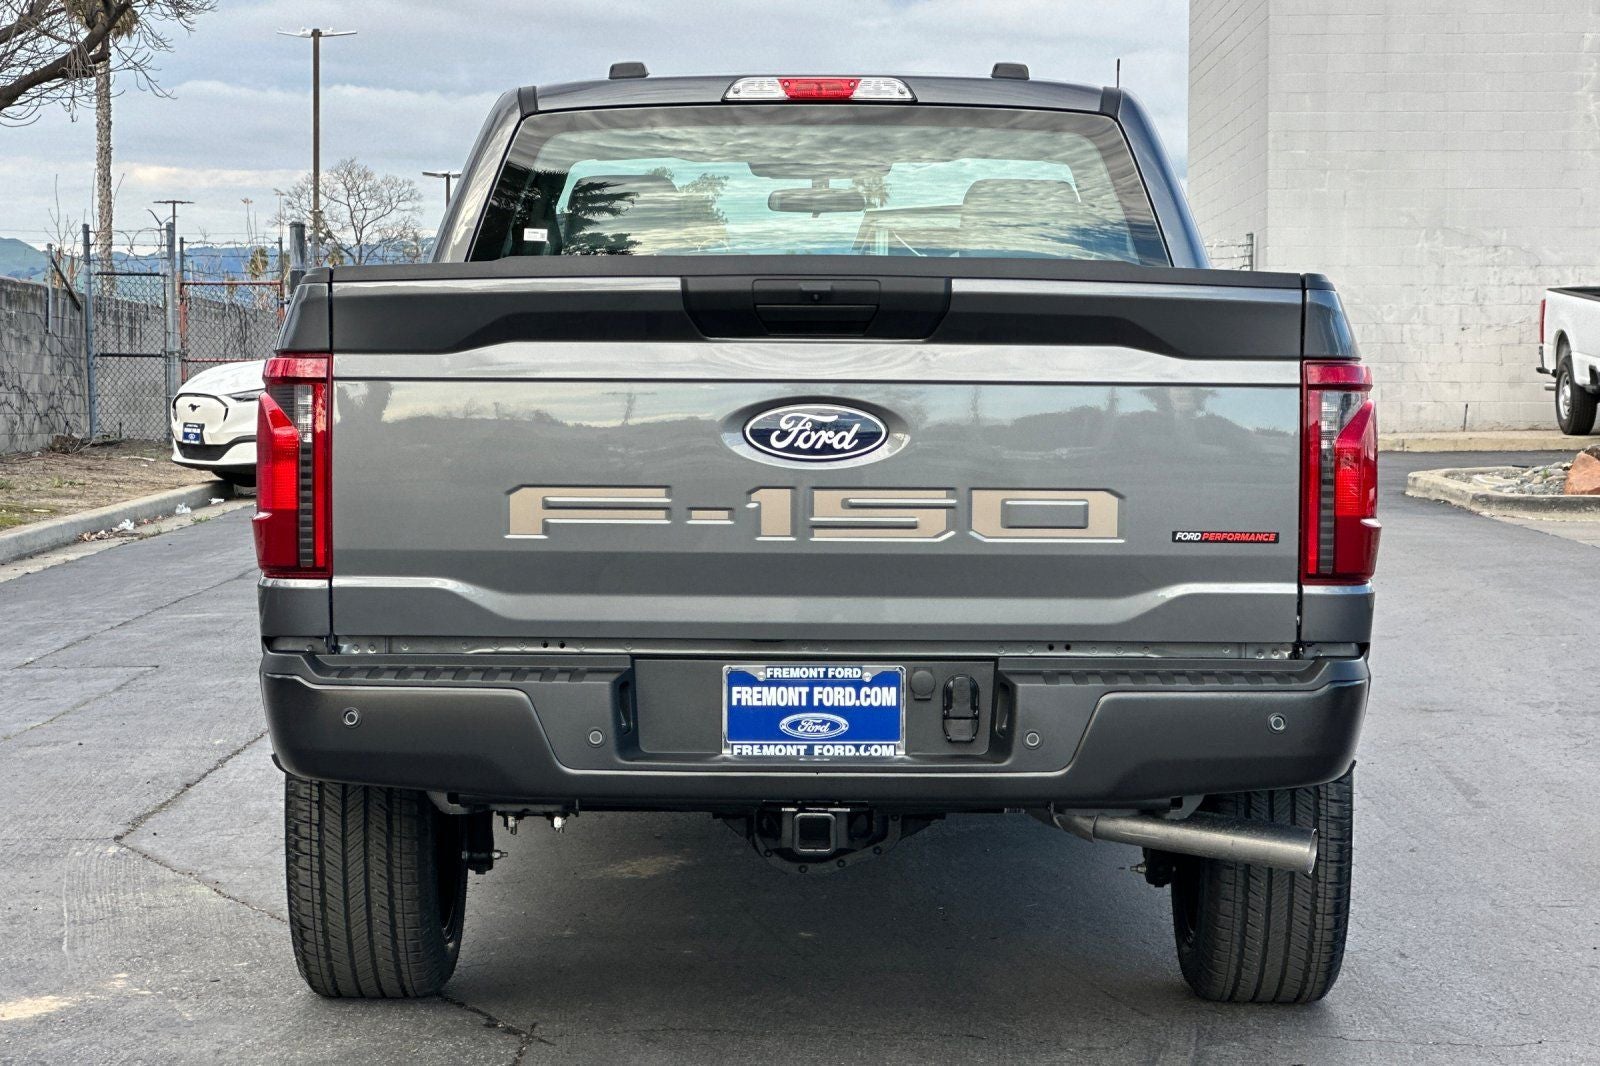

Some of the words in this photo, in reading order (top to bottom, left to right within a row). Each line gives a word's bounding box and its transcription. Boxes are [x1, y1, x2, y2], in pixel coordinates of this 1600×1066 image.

[769, 412, 861, 450] Ford
[504, 485, 1125, 543] F-150
[1175, 532, 1201, 541] FORD
[1202, 532, 1276, 542] PERFORMANCE
[766, 667, 825, 678] FREMONT
[827, 667, 861, 678] FORD
[732, 686, 809, 706] FREMONT
[813, 686, 896, 706] FORD.COM
[797, 718, 831, 733] Ford
[733, 744, 806, 756] FREMONT
[813, 744, 895, 756] FORD.COM
